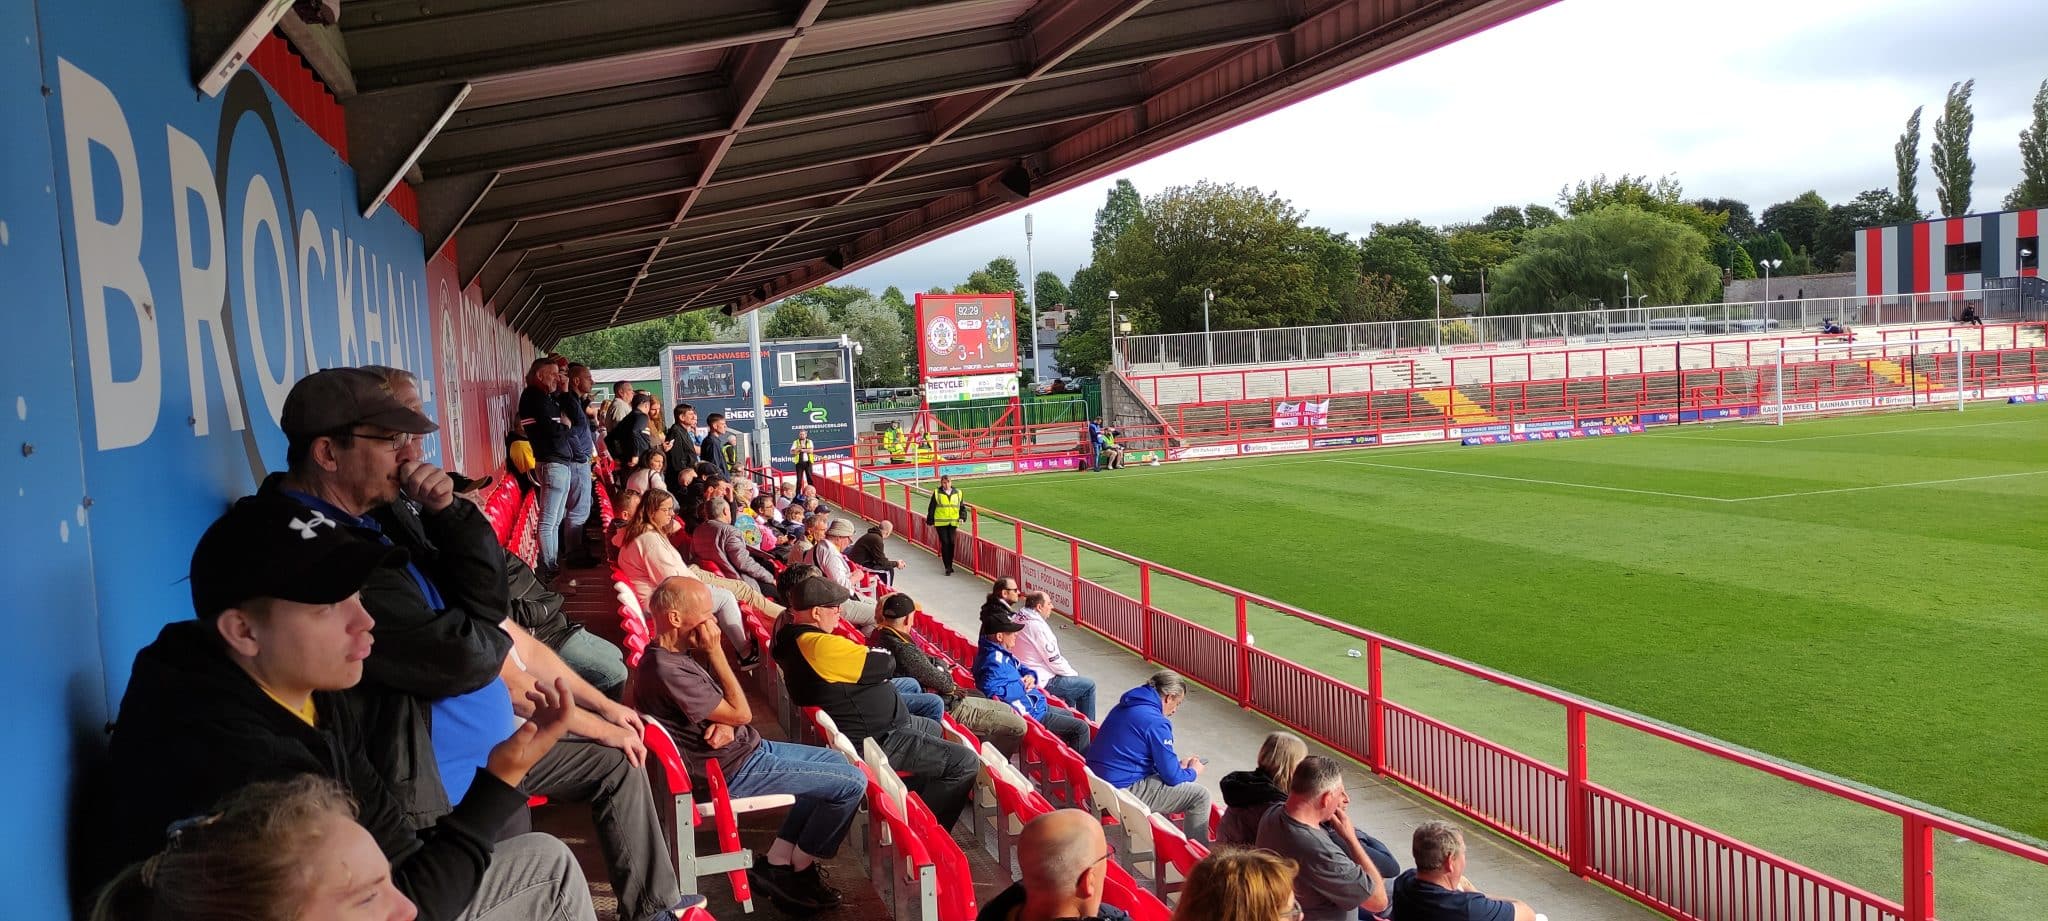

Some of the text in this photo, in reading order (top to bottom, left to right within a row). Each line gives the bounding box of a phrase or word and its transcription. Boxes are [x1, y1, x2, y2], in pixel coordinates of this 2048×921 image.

[57, 56, 432, 452] BROCKHALL
[958, 306, 979, 316] 92:29
[675, 350, 770, 361] HEATEDCANVASESOM
[1820, 398, 1871, 409] RAINHAM STEEL
[1762, 404, 1792, 413] RAINAM
[725, 408, 788, 420] ENERG GUYS
[1529, 432, 1540, 440] sky
[1557, 430, 1570, 439] sky
[1588, 428, 1600, 436] sky
[1468, 437, 1480, 445] sky
[1498, 434, 1511, 442] sky
